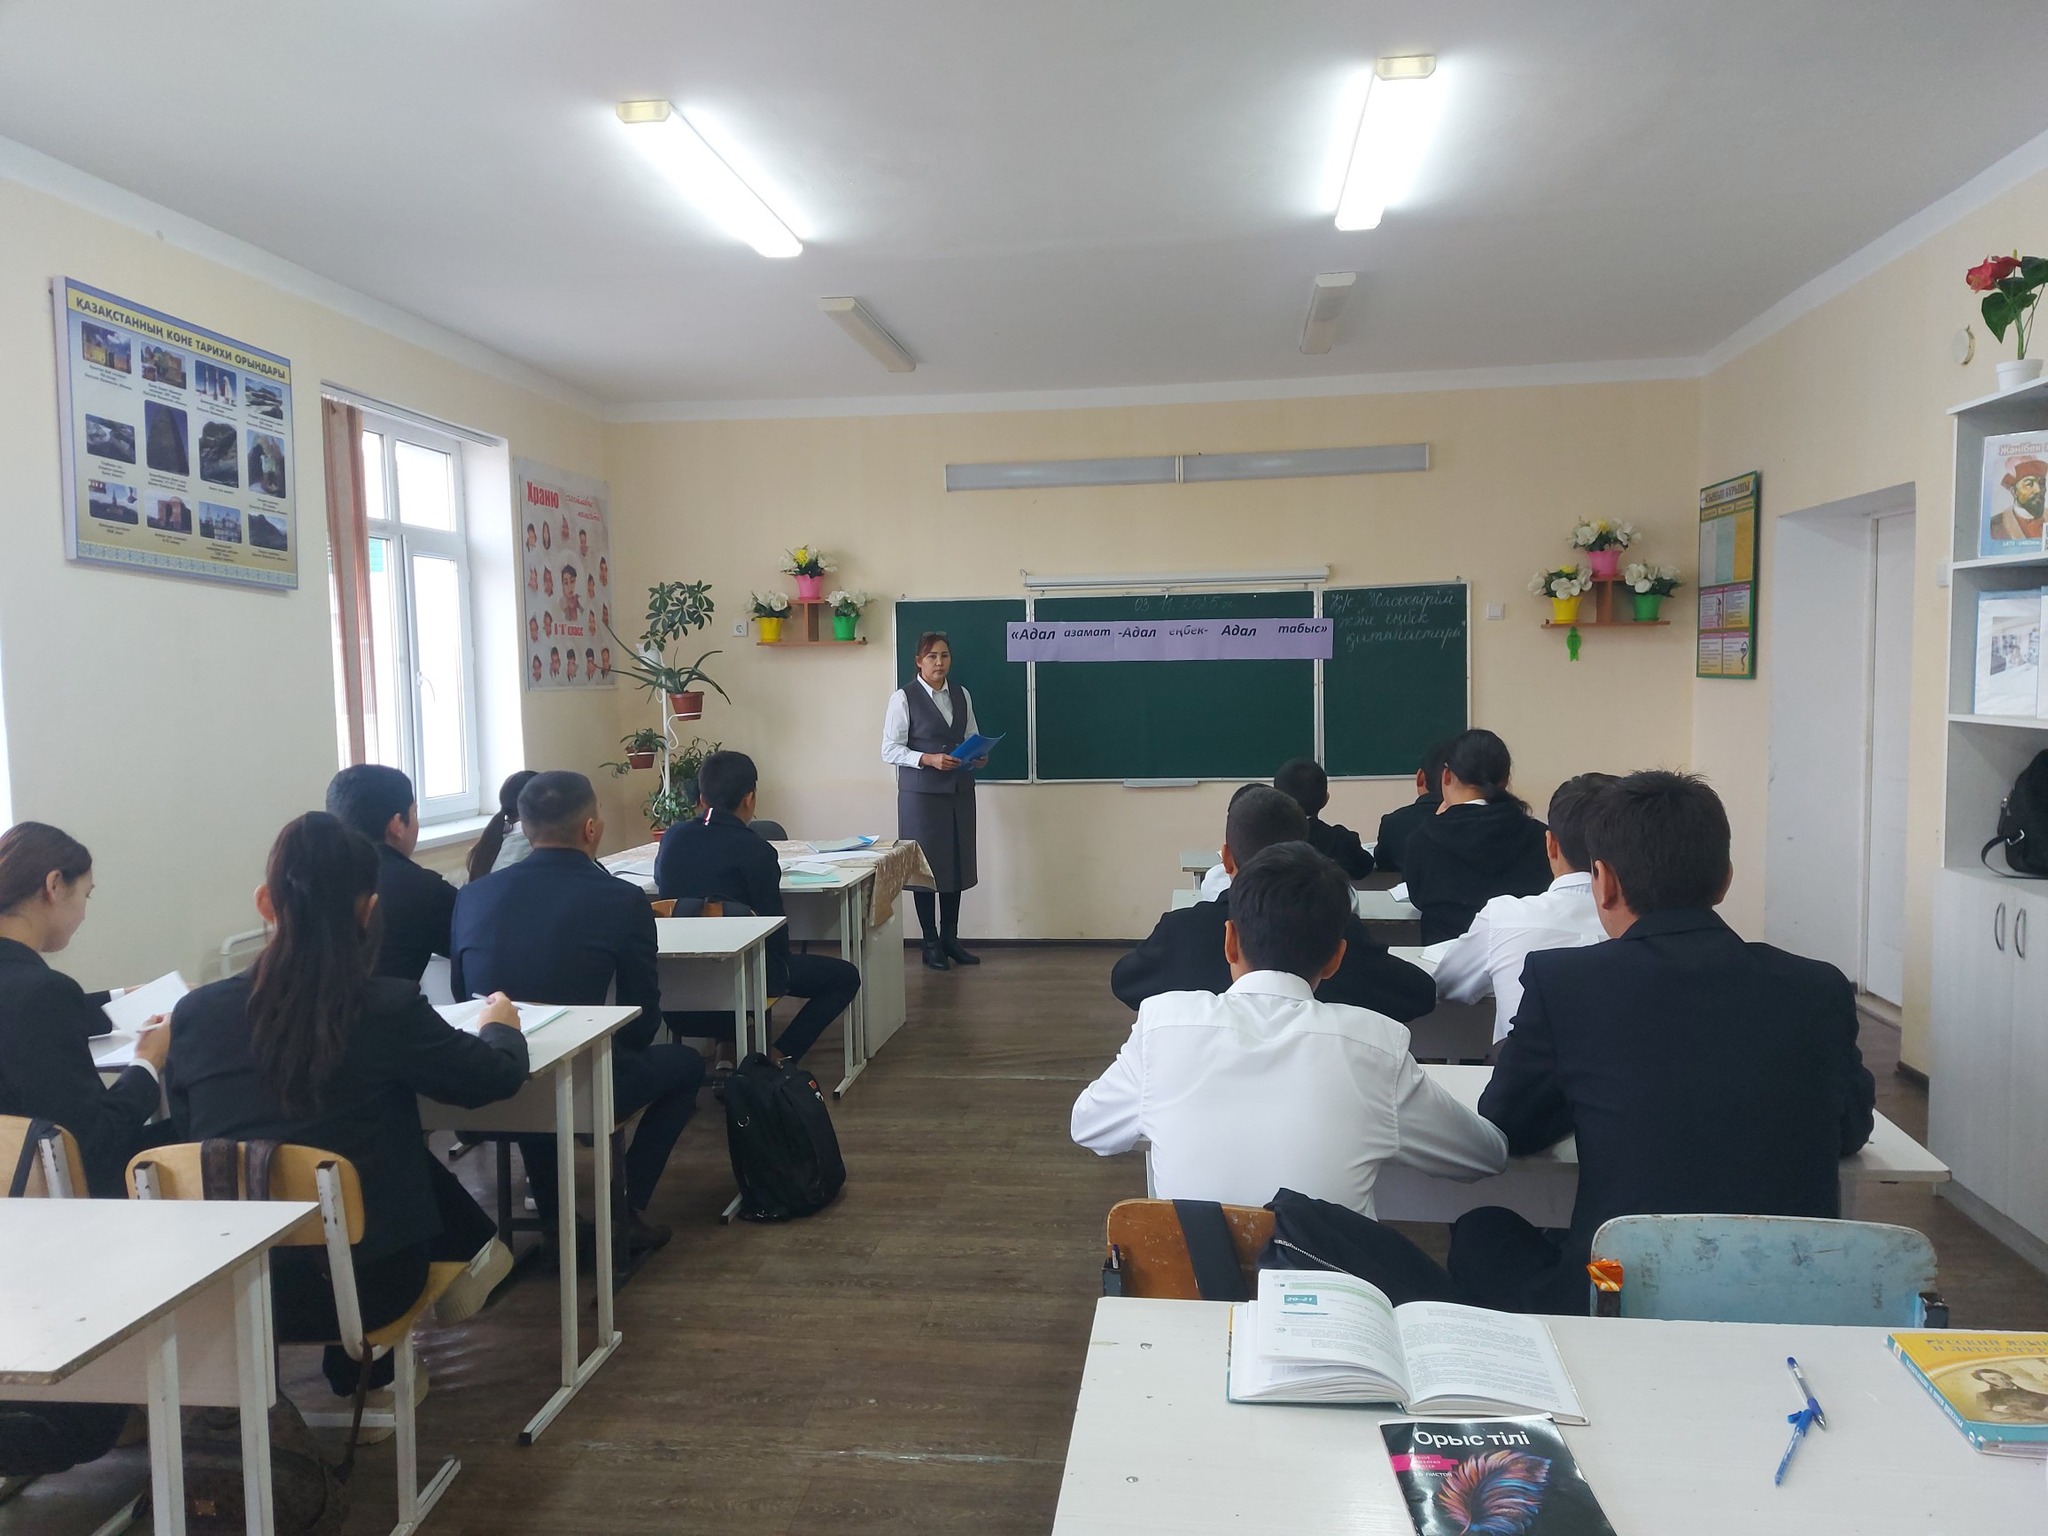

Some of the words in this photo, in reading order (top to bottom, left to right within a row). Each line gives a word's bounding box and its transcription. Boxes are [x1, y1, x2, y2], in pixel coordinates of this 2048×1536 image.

[195, 340, 232, 361] ТАРИХИ
[235, 354, 285, 379] ОРЫНДАРЫ
[526, 481, 559, 509] Храню
[1011, 627, 1056, 642] «Адал
[1064, 628, 1111, 637] азамат
[1118, 625, 1157, 640] -Адал
[1169, 625, 1208, 638] еңбек-
[1221, 624, 1257, 638] Адал
[1278, 623, 1328, 636] табыс»
[1414, 1431, 1485, 1448] Орыс
[1487, 1431, 1530, 1446] тілі
